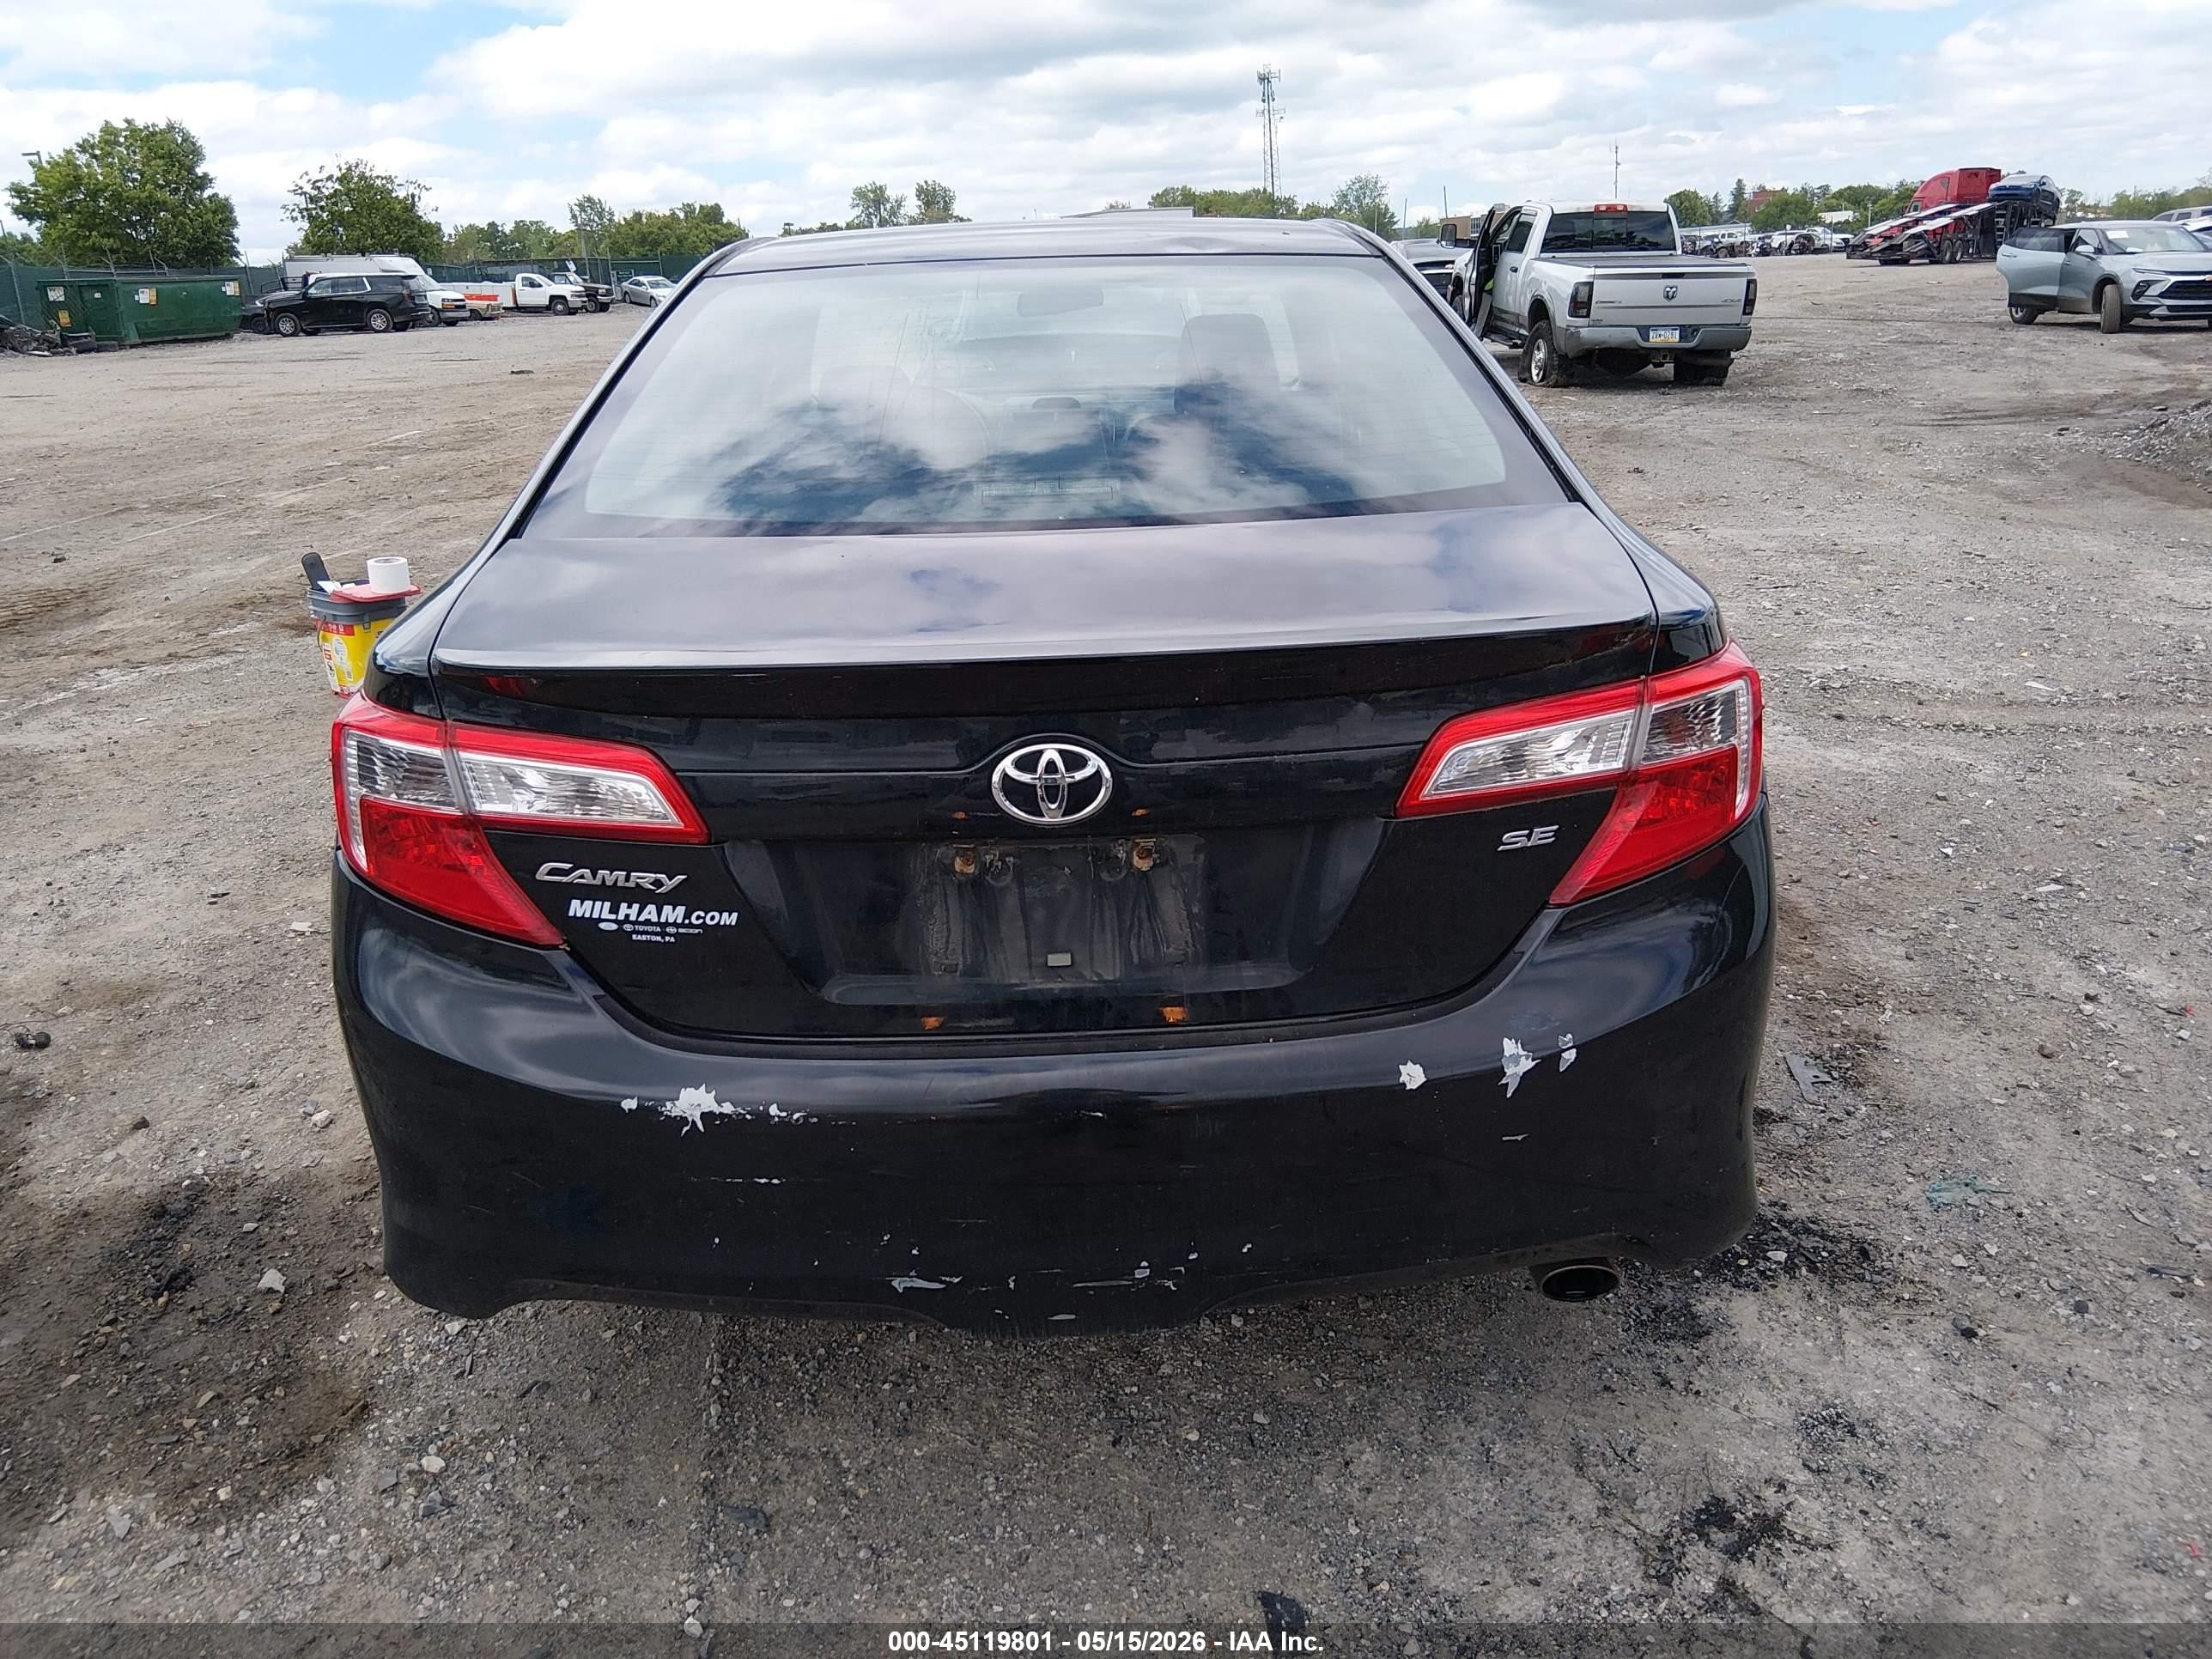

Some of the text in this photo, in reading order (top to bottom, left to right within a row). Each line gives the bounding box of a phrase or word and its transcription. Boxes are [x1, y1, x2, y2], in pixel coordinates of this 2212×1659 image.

[1498, 825, 1559, 851] SE
[535, 862, 688, 894] CAMRY
[568, 899, 738, 927] MILHAM.COM
[632, 933, 664, 943] EASTON,
